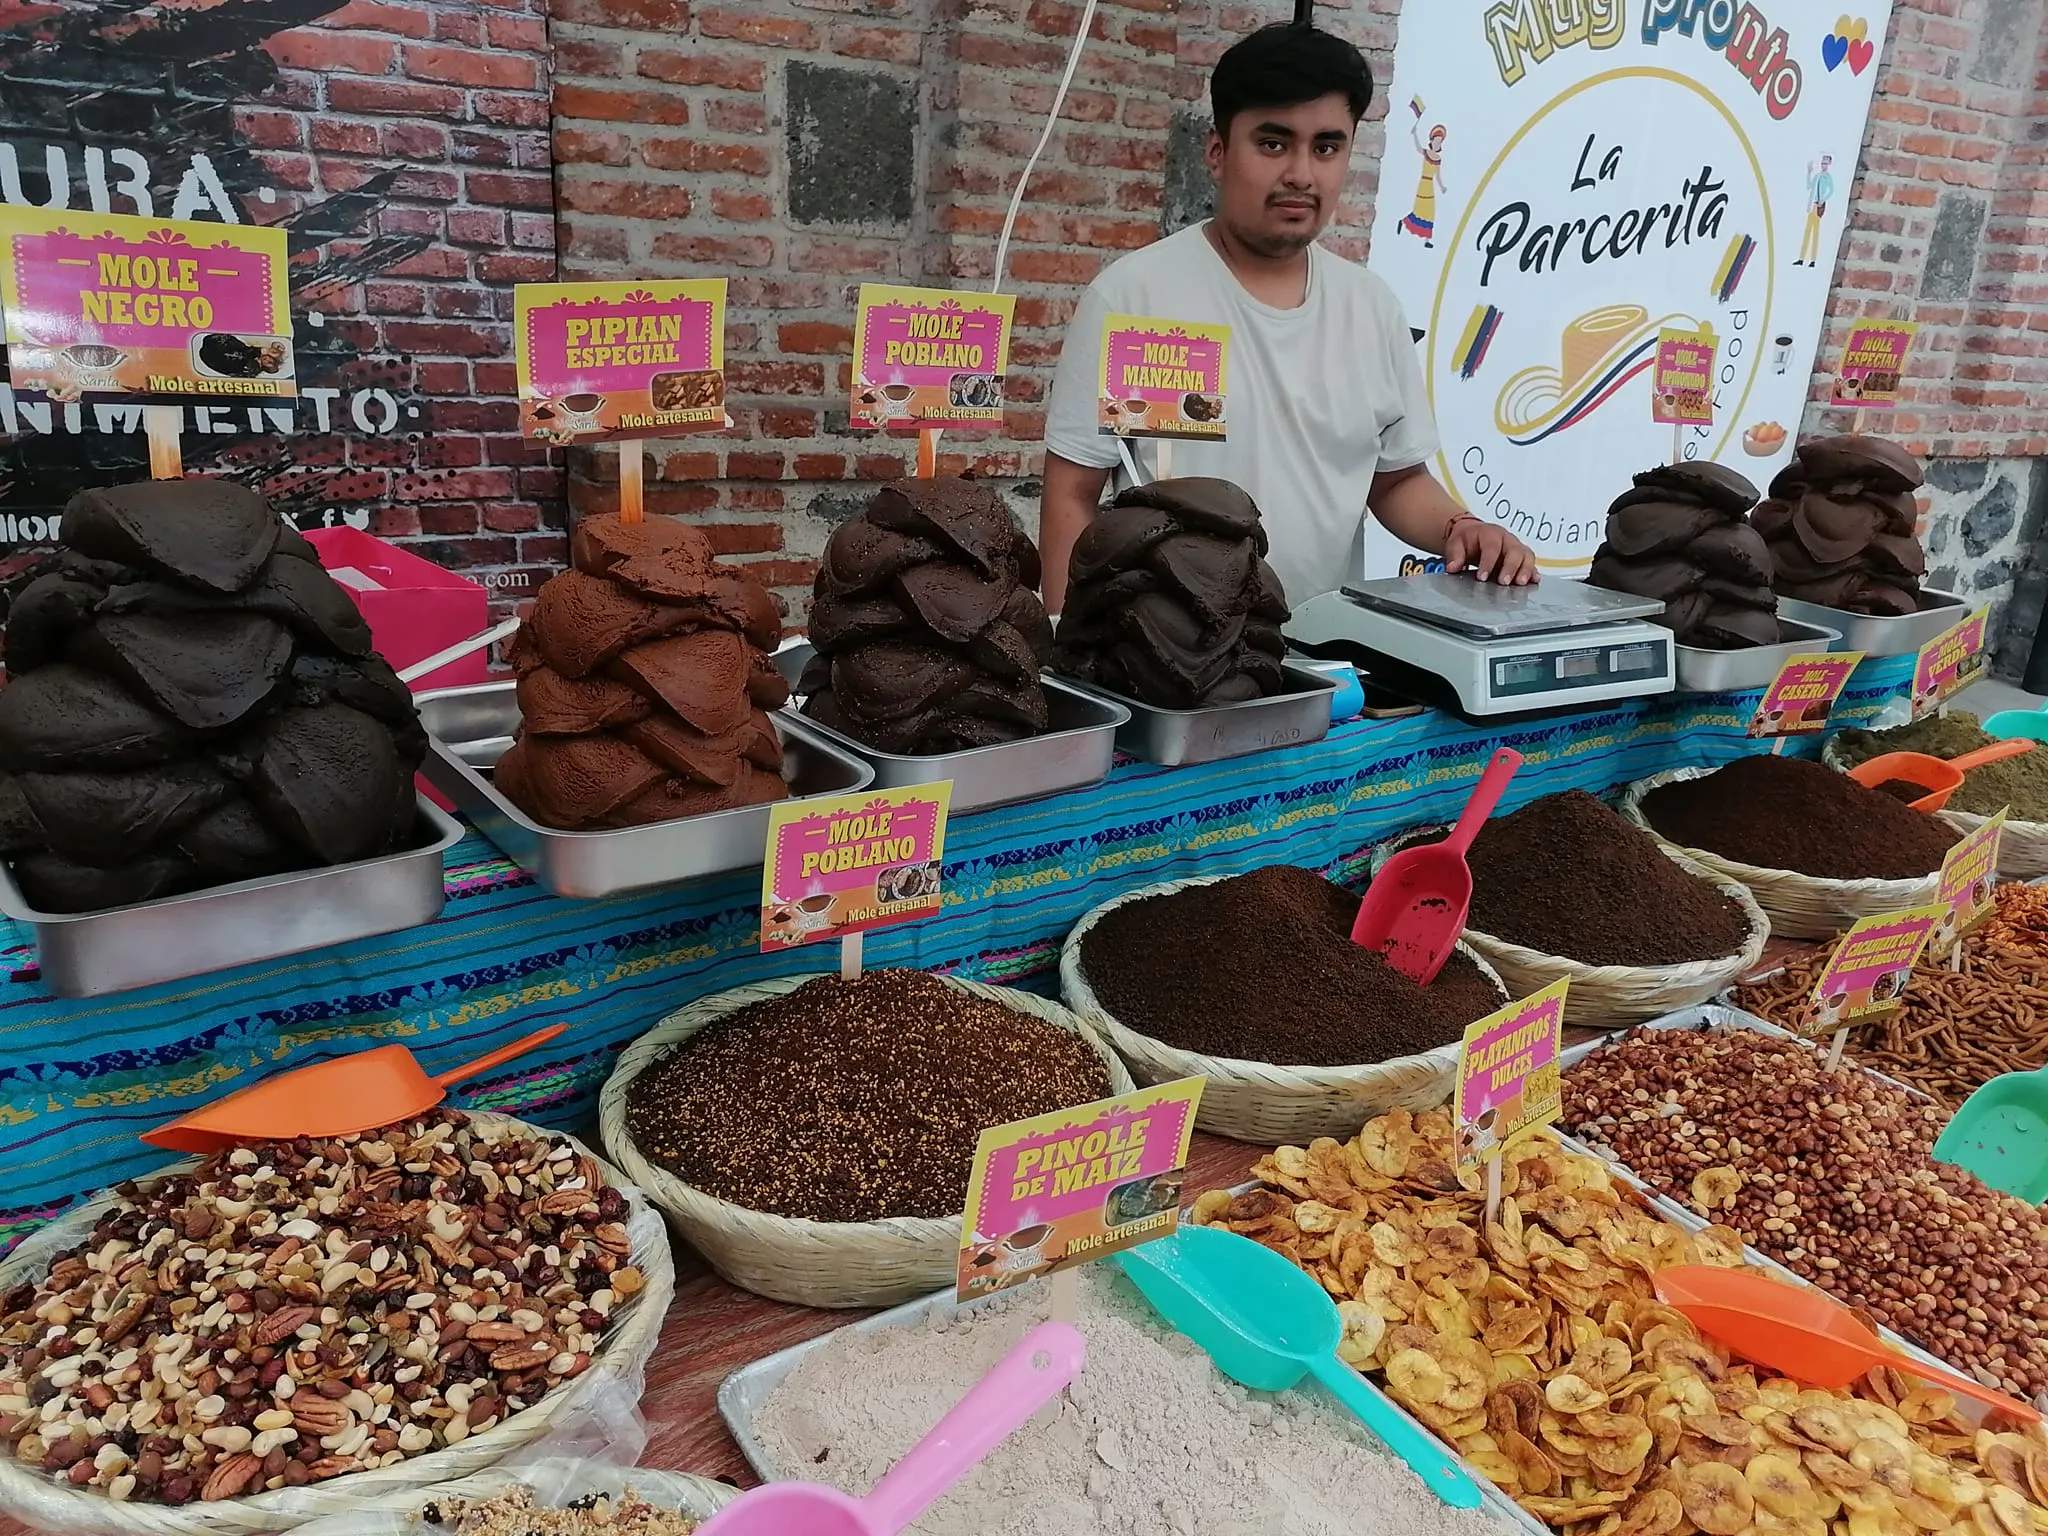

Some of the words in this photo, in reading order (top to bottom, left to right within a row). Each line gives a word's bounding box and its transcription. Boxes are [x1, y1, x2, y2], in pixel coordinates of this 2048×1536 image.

[1484, 0, 1625, 88] Muy
[1641, 0, 1802, 120] pronto
[1570, 133, 1622, 192] La
[1476, 166, 1728, 286] Parcerita
[97, 253, 200, 292] MOLE
[79, 290, 214, 329] NEGRO
[565, 314, 682, 347] PIPIAN
[908, 313, 964, 340] MOLE
[566, 343, 680, 369] ESPECIAL
[885, 340, 983, 369] POBLANO
[1143, 342, 1189, 367] MOLE
[1847, 351, 1899, 369] ESPECIAL
[1861, 337, 1896, 352] MOLE
[149, 375, 195, 393] Mole
[198, 377, 281, 395] artesanal
[1123, 365, 1206, 391] MANZANA
[621, 413, 653, 428] Mole
[655, 409, 715, 425] artesanal
[924, 406, 949, 419] Mole
[949, 406, 995, 419] artesanal
[1159, 419, 1181, 432] Mole
[1181, 421, 1220, 433] artesanal
[1463, 446, 1599, 543] Colombian
[1801, 670, 1828, 682] MOLE
[1928, 643, 1968, 678] VERDE
[1778, 683, 1829, 701] CASERO
[827, 812, 894, 845] MOLE
[800, 835, 916, 878] POBLANO
[848, 907, 877, 922] Mole
[878, 897, 930, 917] artesanal
[1467, 1013, 1551, 1080] PLATANITOS
[1490, 1051, 1533, 1092] DULCES
[1506, 1116, 1525, 1135] Mole
[1525, 1096, 1557, 1125] artesanal
[1013, 1118, 1151, 1180] PINOLE
[1011, 1176, 1046, 1202] DE
[1051, 1147, 1145, 1198] MAIZ
[1067, 1233, 1103, 1256] Mole
[1104, 1212, 1170, 1243] artesanal
